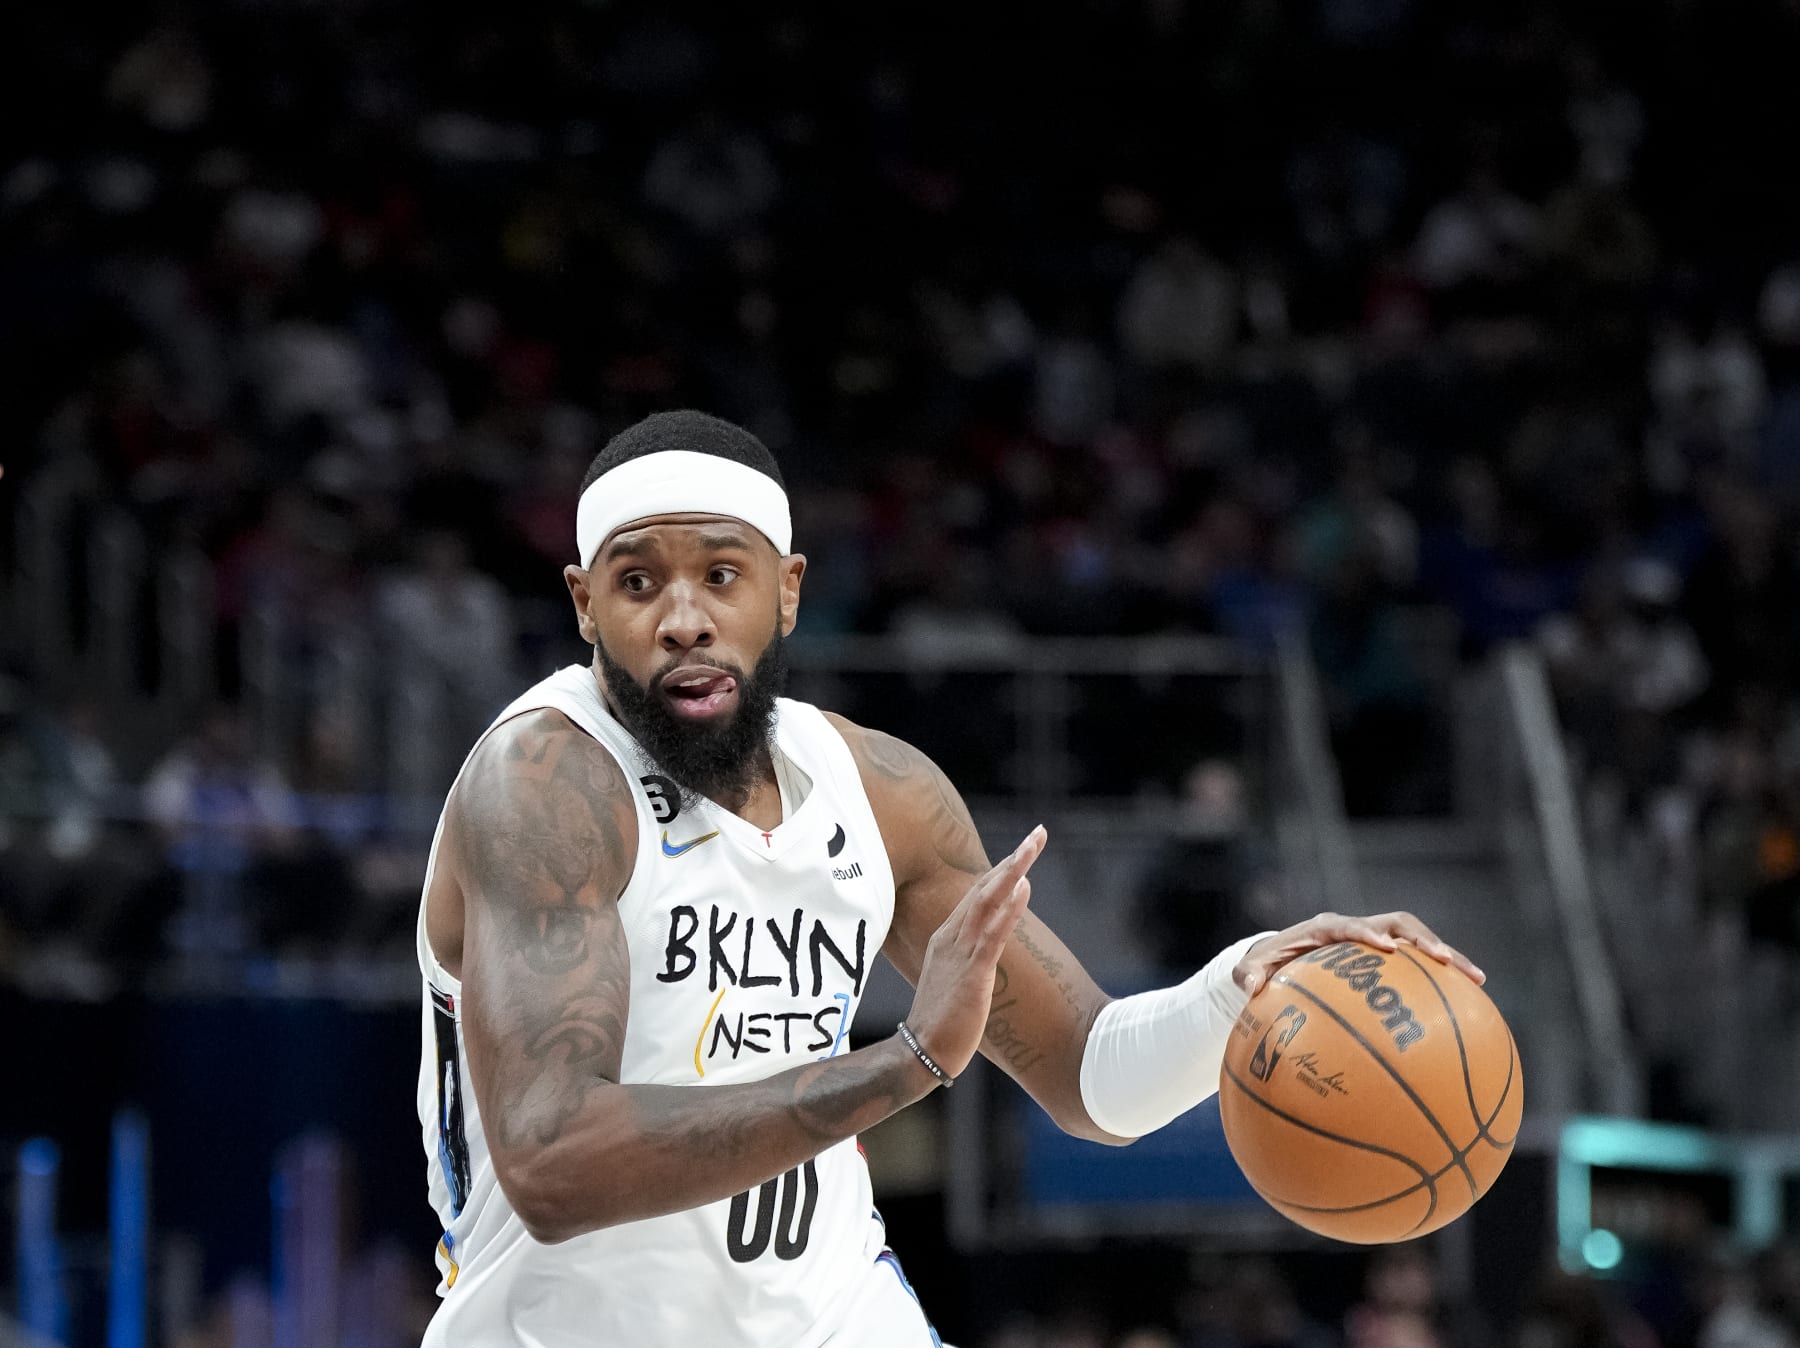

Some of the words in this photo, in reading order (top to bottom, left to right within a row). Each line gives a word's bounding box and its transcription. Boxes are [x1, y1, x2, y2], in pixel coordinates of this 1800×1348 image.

[831, 862, 863, 881] ebull
[656, 904, 866, 997] BKLYN
[708, 1006, 841, 1059] NETS
[727, 1158, 819, 1263] 00
